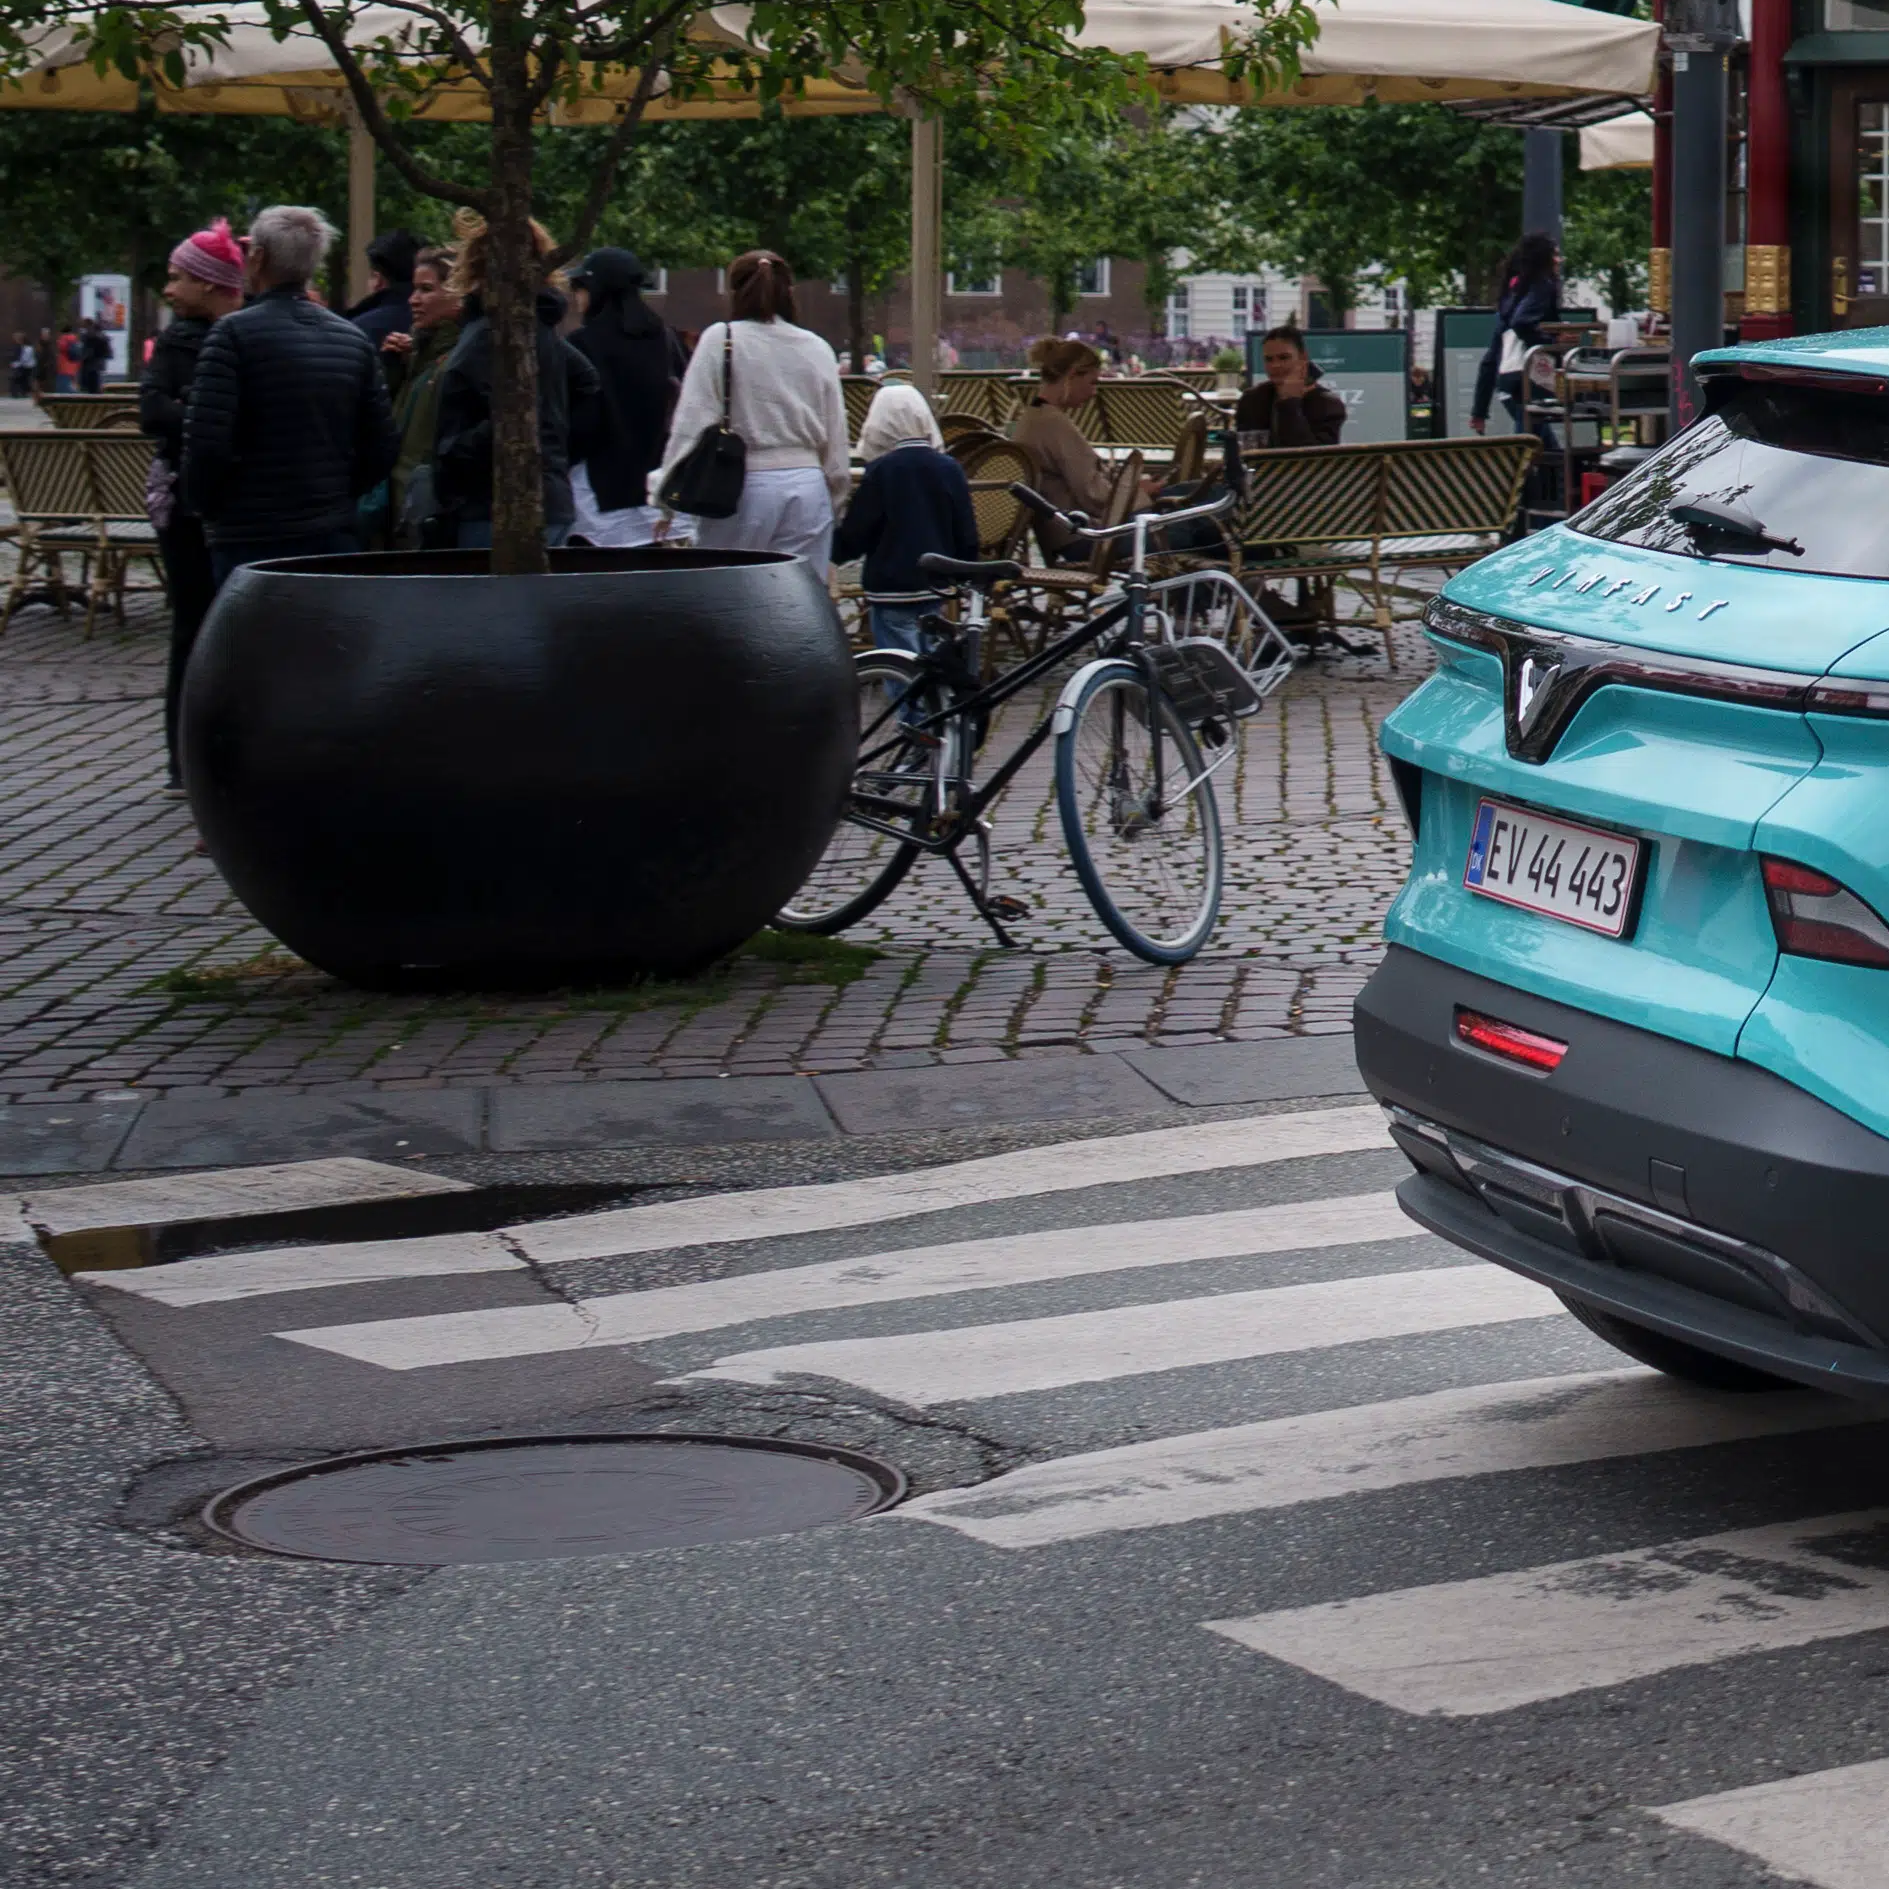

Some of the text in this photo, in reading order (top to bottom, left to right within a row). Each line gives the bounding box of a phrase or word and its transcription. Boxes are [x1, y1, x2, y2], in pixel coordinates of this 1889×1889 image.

[1527, 567, 1730, 621] VINFAST
[1469, 851, 1485, 872] DK
[1486, 819, 1627, 916] EV 44 443
